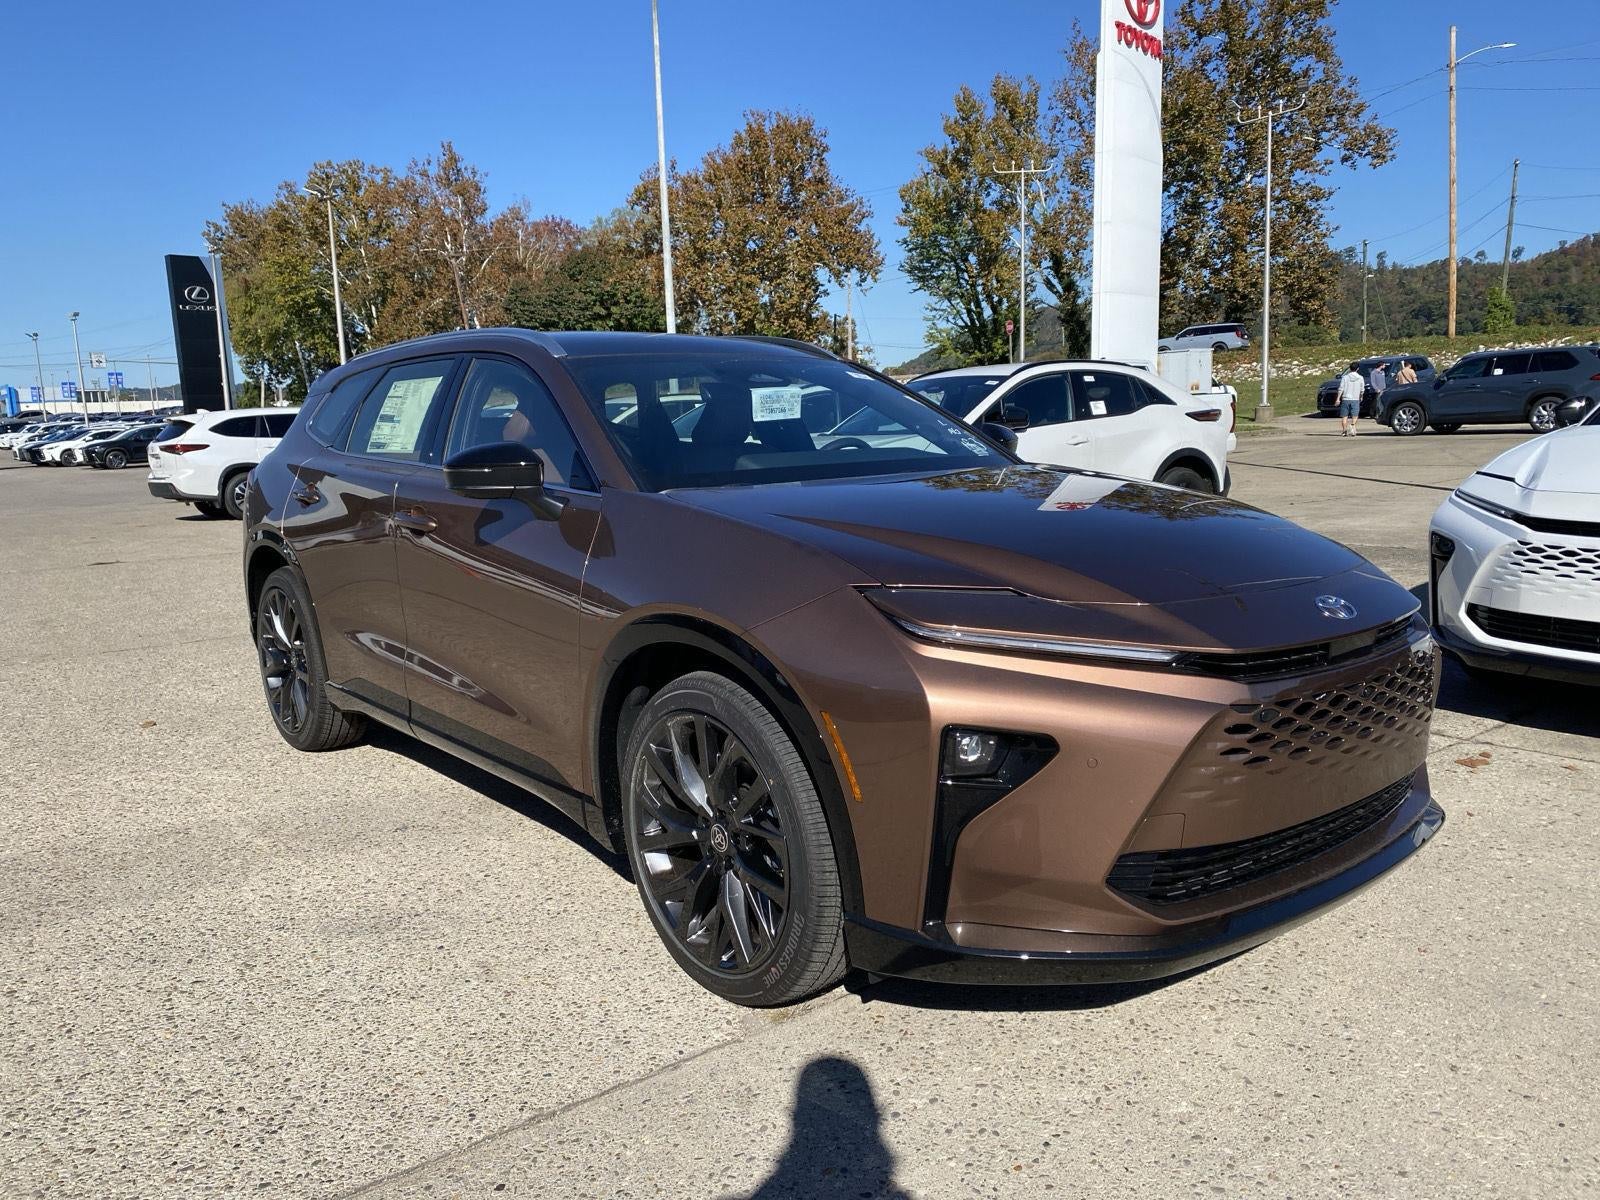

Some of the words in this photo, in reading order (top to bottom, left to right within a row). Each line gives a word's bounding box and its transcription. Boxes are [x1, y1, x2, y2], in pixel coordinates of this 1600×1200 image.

[1115, 20, 1163, 62] TOYOTA
[179, 304, 217, 312] LEXUS
[762, 911, 804, 987] BRIDGESTONE
